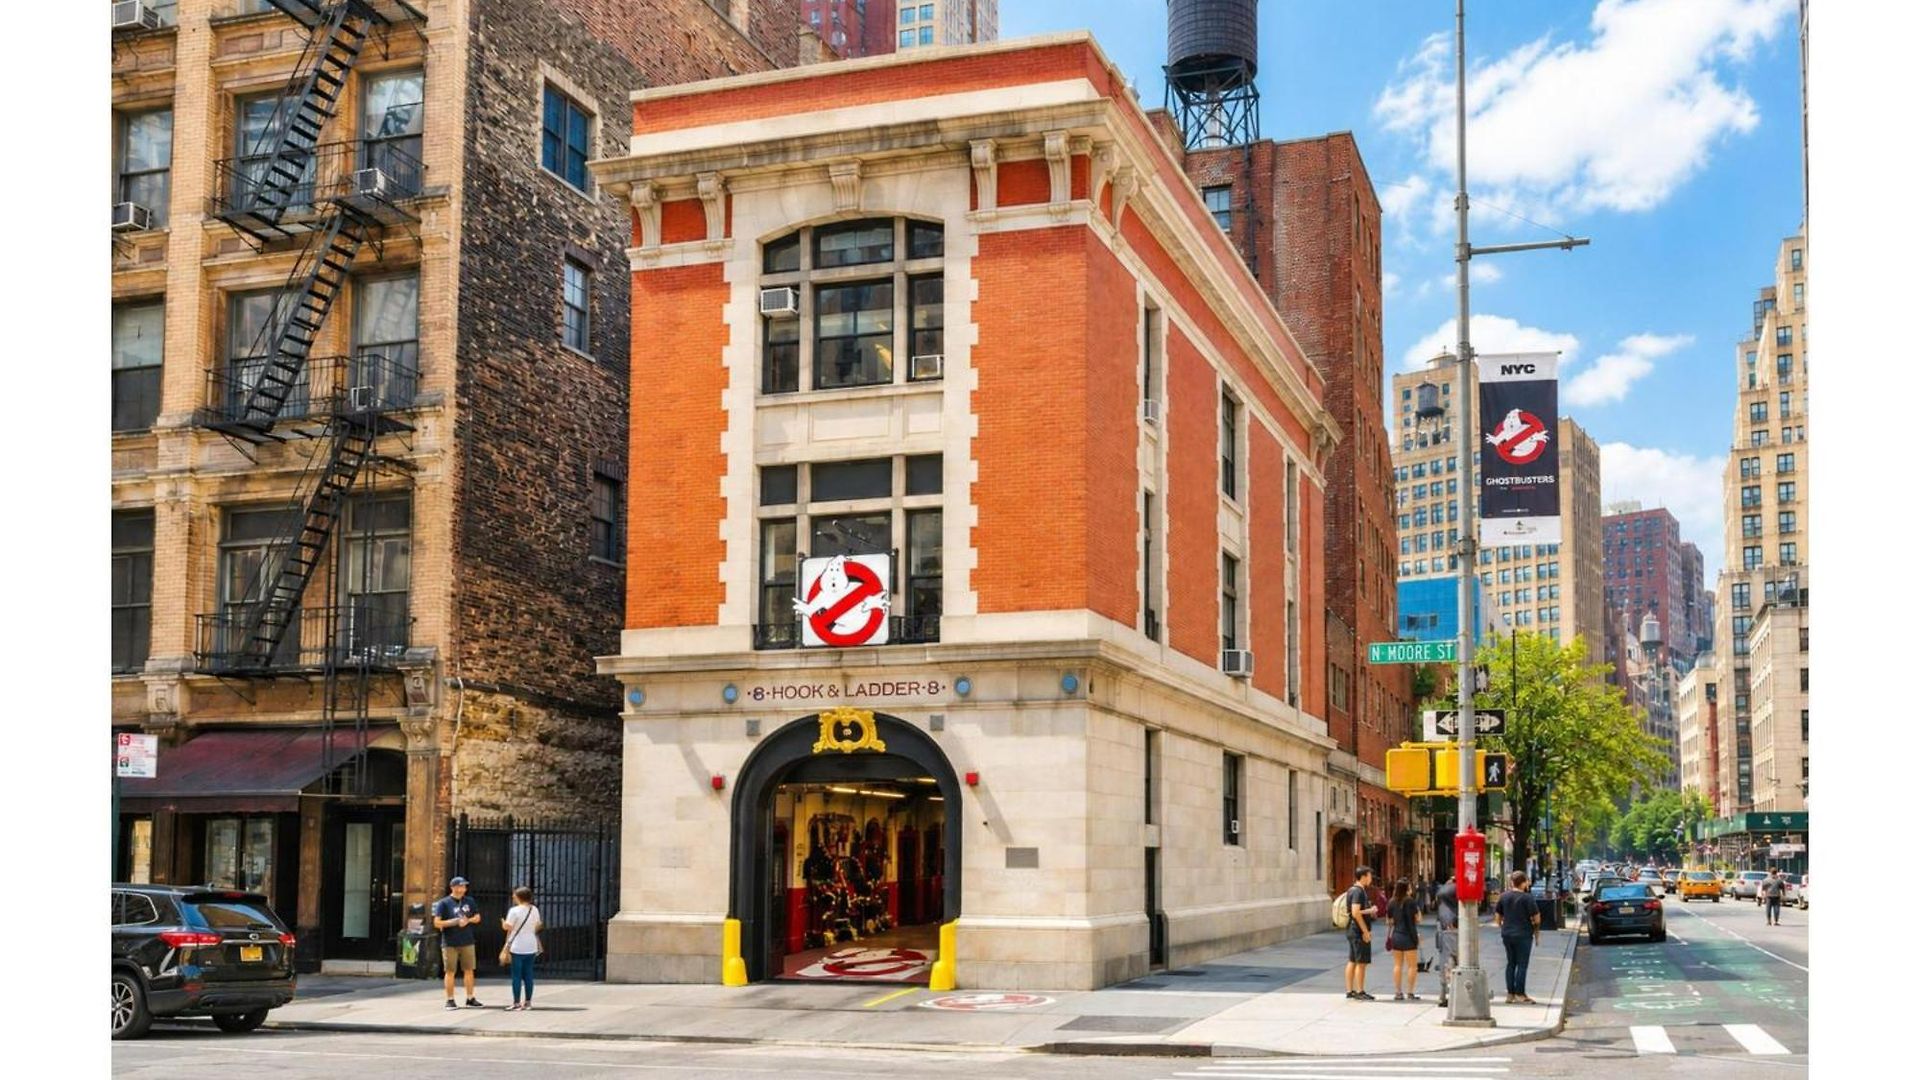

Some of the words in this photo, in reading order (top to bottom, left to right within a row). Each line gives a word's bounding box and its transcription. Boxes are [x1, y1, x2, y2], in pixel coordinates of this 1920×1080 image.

[1501, 364, 1536, 375] NYC
[1486, 475, 1555, 485] GHOSTBUSTERS
[1388, 644, 1432, 661] MOORE
[1437, 643, 1454, 660] ST
[827, 685, 839, 698] &
